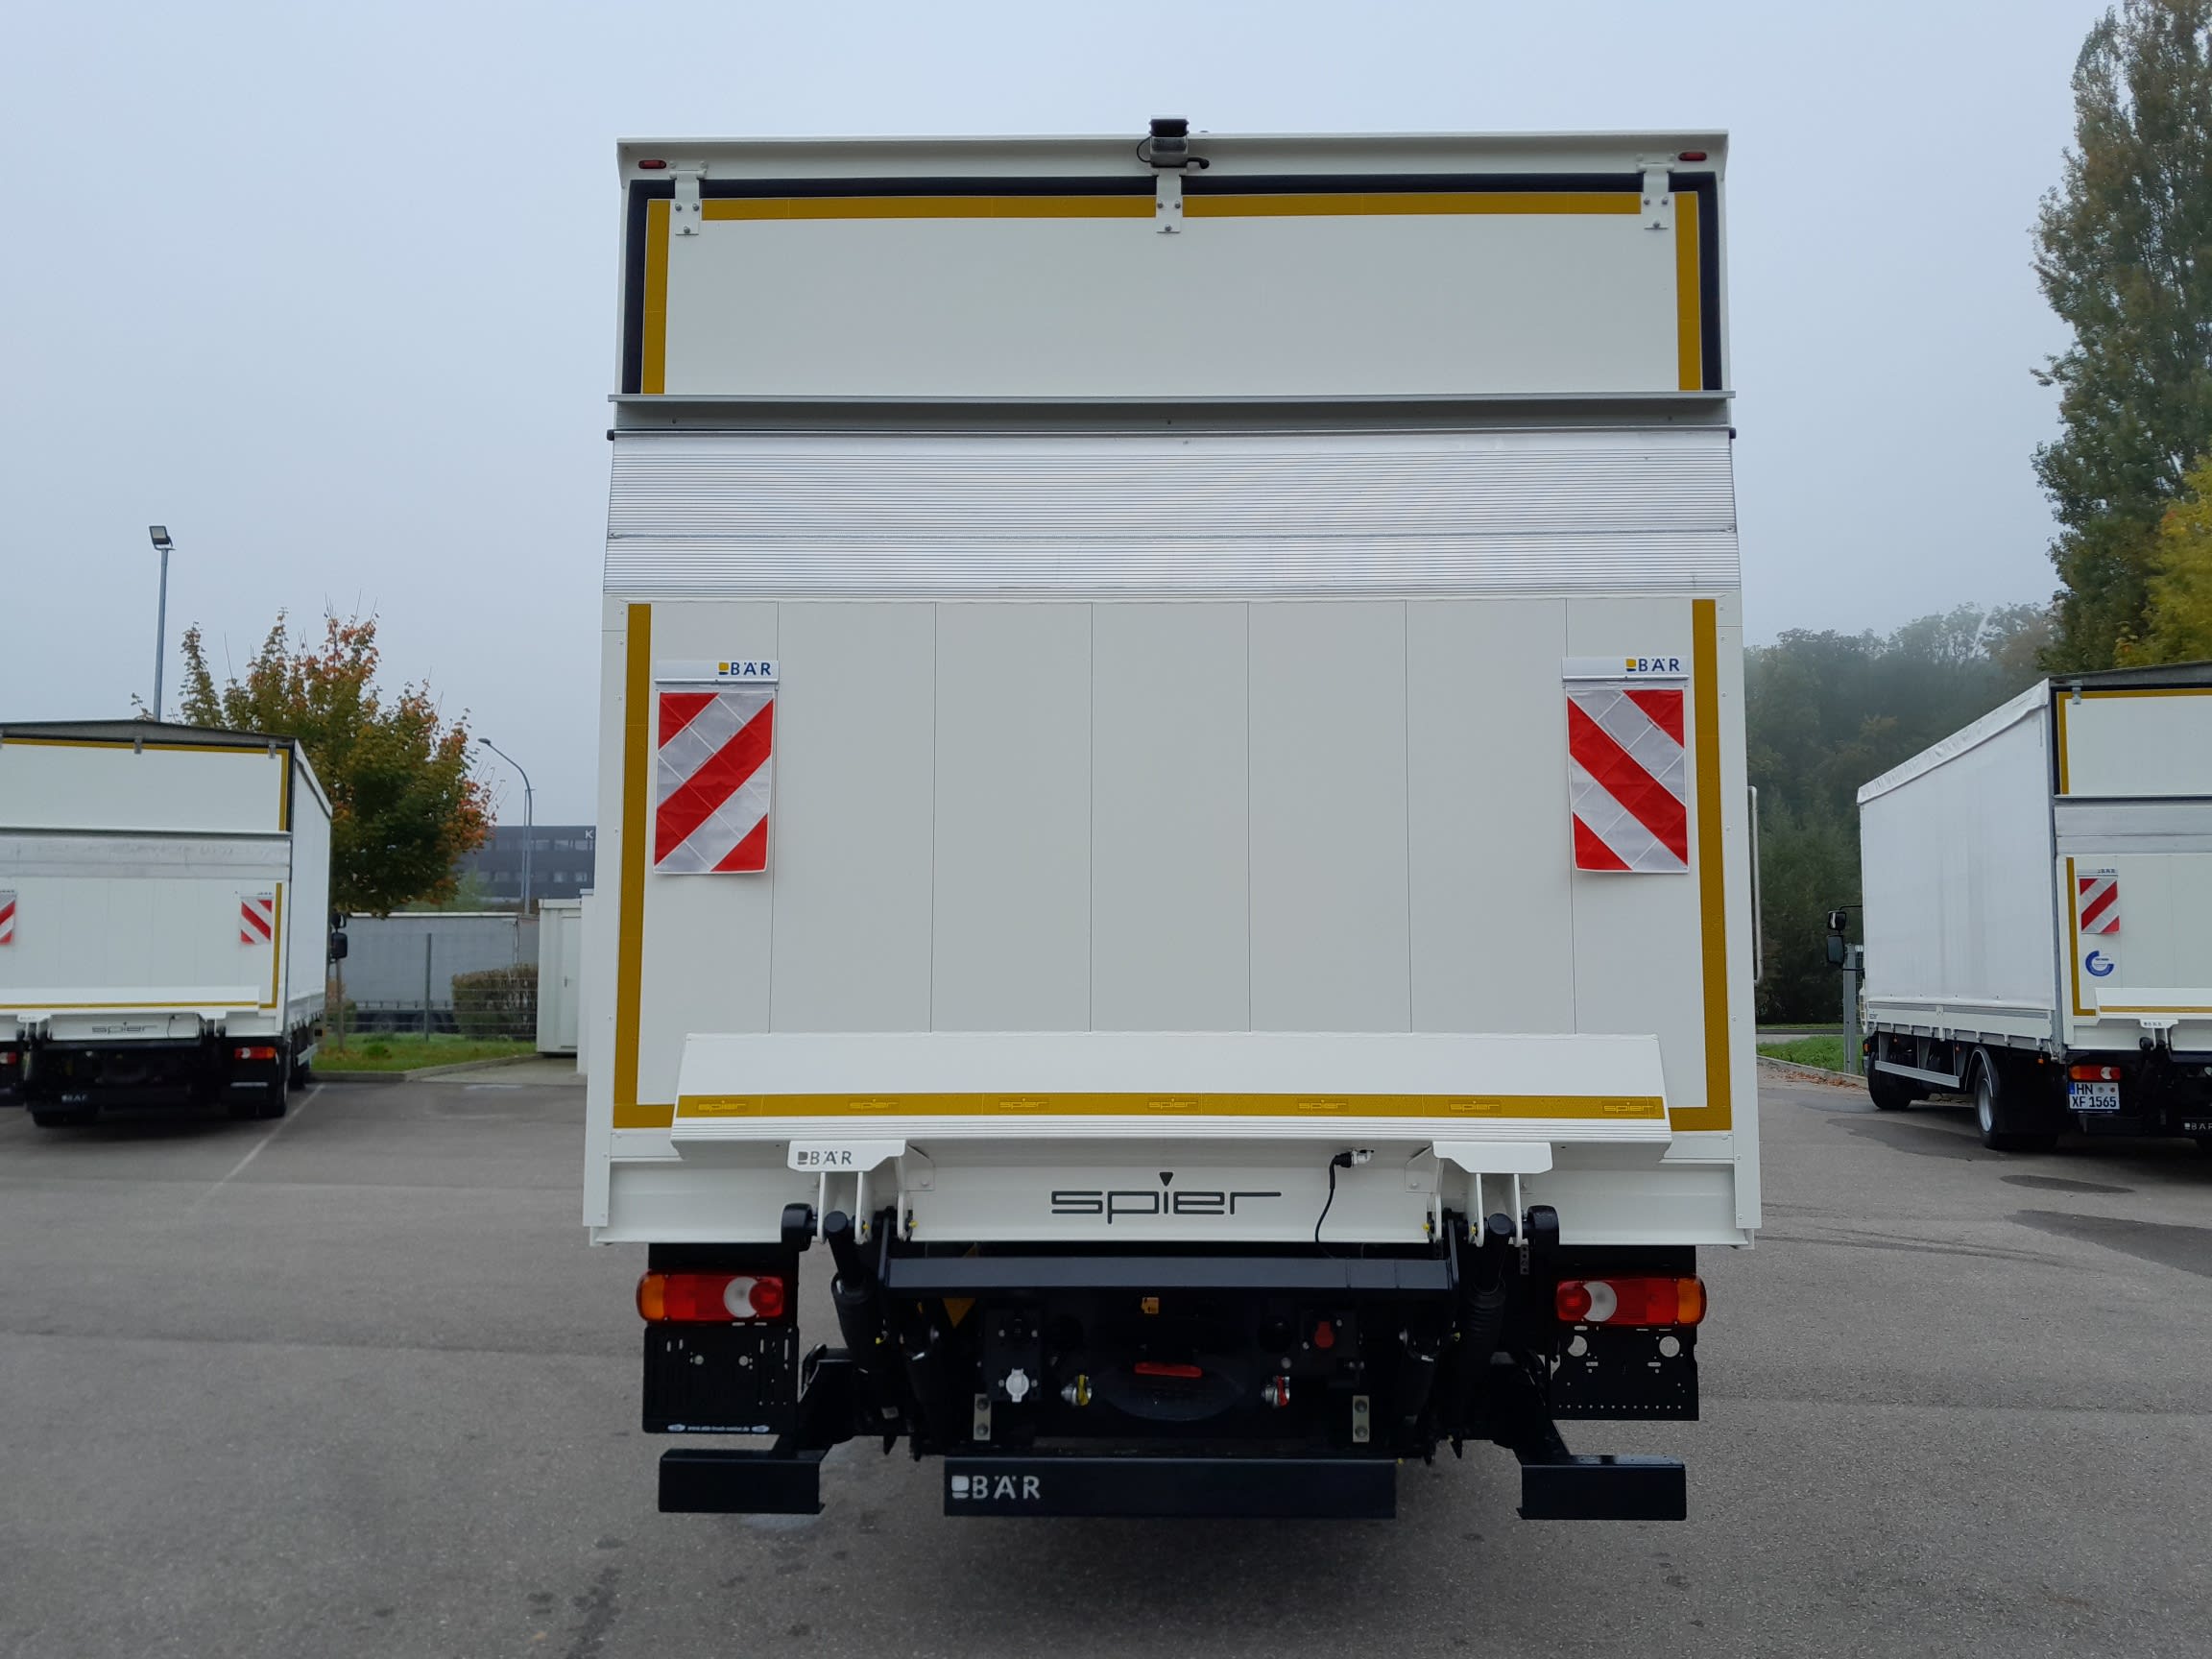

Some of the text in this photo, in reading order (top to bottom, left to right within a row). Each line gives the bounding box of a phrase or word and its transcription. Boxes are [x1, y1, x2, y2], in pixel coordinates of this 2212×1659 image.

[730, 661, 771, 676] BÄR
[1638, 658, 1680, 672] BÄR
[2077, 1083, 2093, 1095] HN
[2072, 1096, 2117, 1108] XF 1565
[809, 1150, 853, 1165] BÄR
[1051, 1172, 1282, 1224] spier
[972, 1474, 1041, 1500] BÄR
